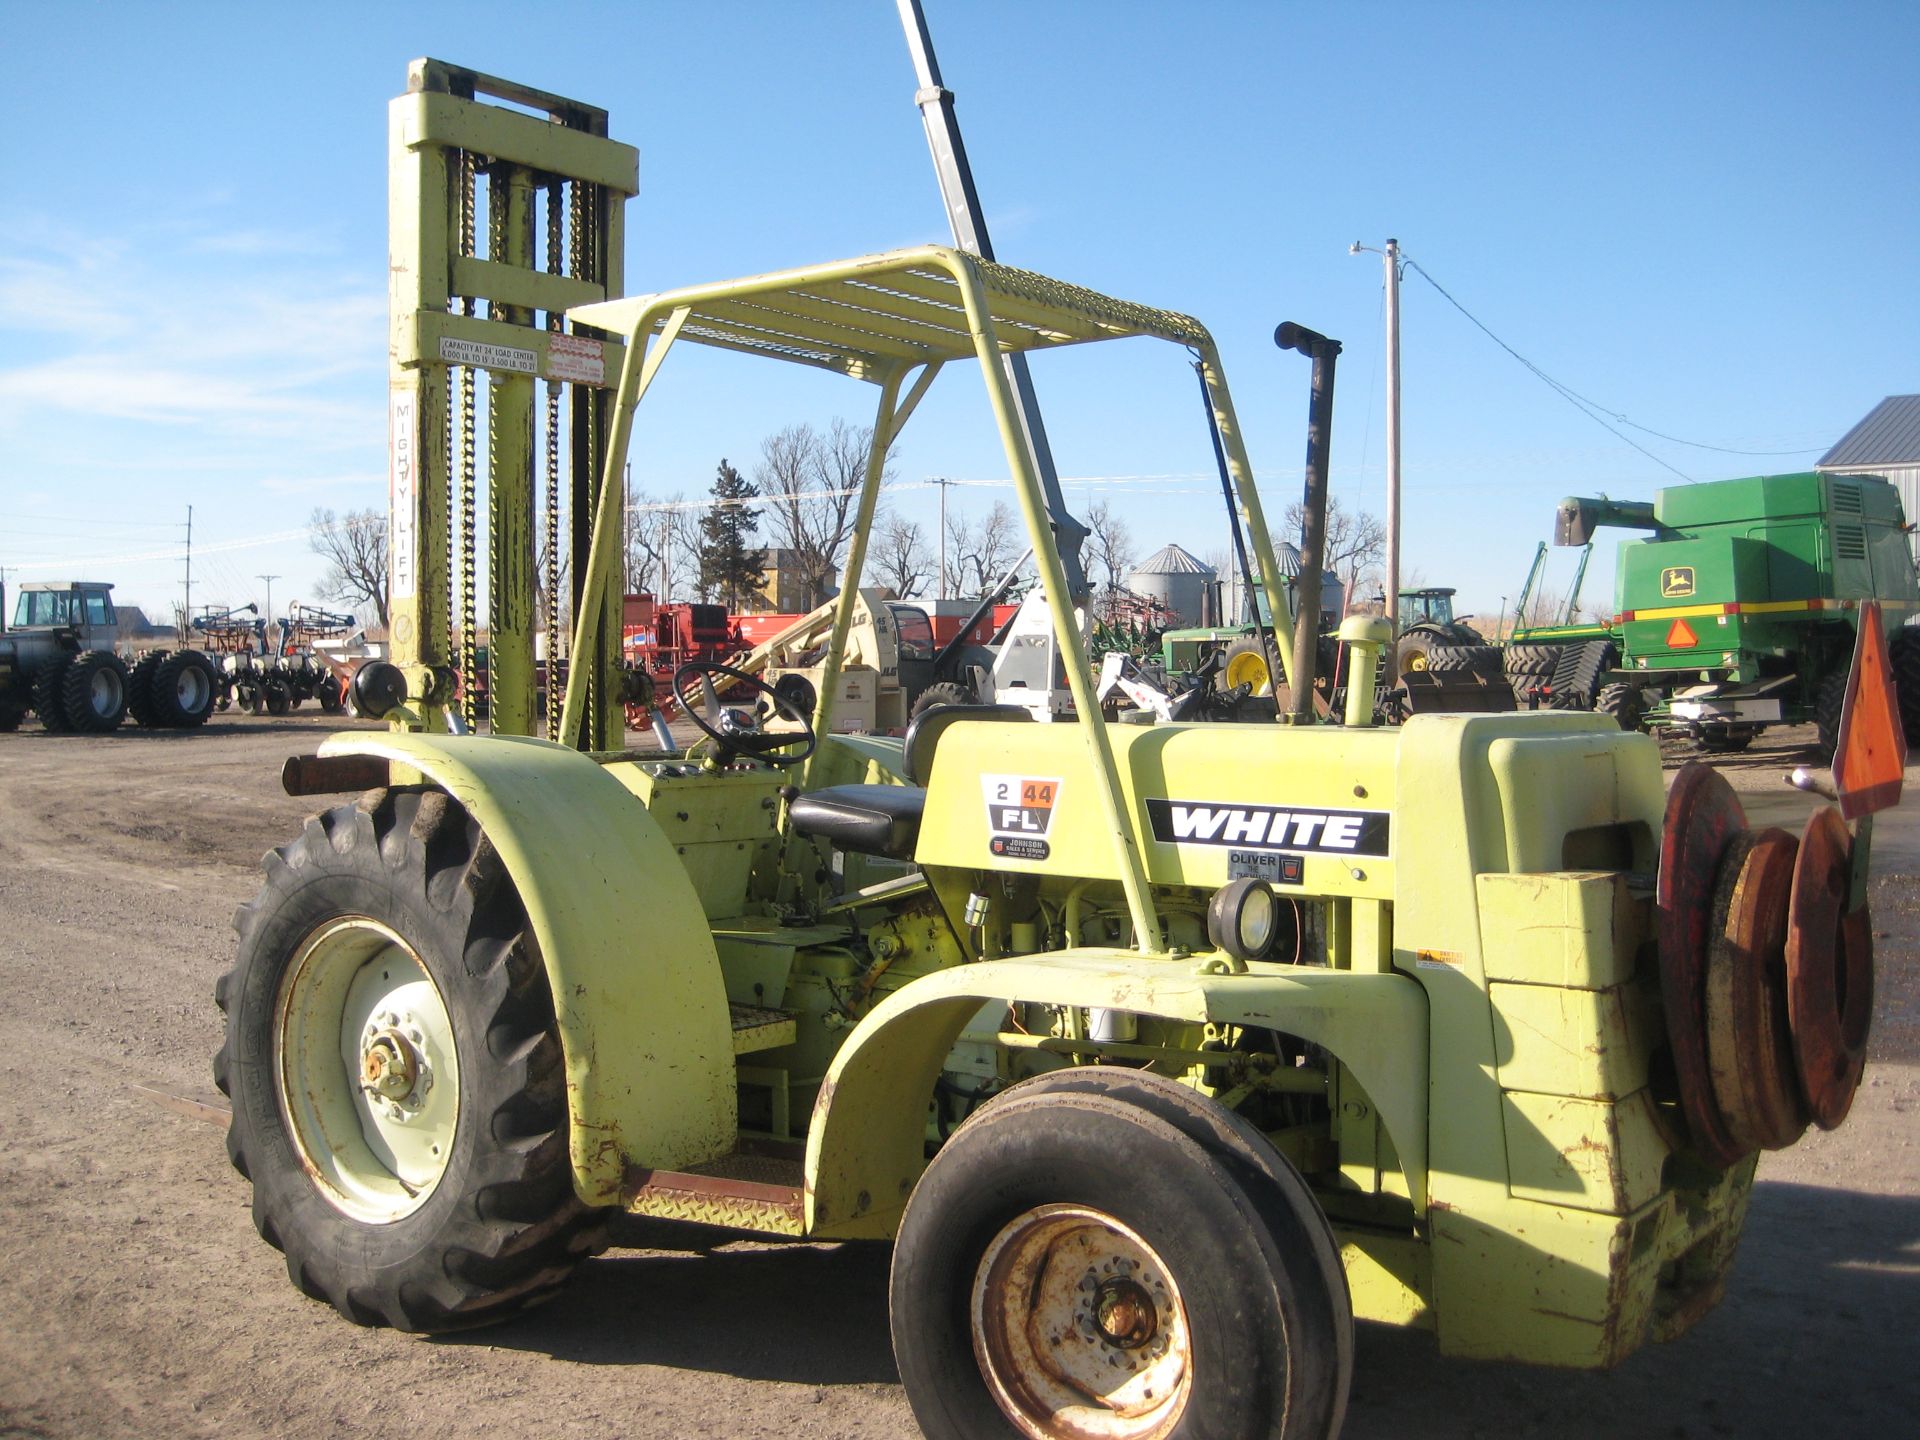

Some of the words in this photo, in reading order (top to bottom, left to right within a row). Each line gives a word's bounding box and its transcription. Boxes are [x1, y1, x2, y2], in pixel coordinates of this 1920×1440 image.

[444, 340, 473, 352] CAPACITY
[475, 345, 482, 353] AT
[495, 348, 511, 358] LOAD
[513, 351, 534, 361] CENTER
[472, 354, 481, 362] TO
[519, 361, 528, 369] TO
[852, 612, 867, 628] LG
[876, 617, 886, 625] 45
[881, 666, 897, 677] JLG
[997, 783, 1008, 800] 2
[1023, 785, 1051, 803] 44
[1171, 806, 1364, 848] WHITE
[1010, 839, 1043, 848] JOHNSON
[1231, 853, 1277, 866] OLIVER
[1248, 865, 1259, 873] THE
